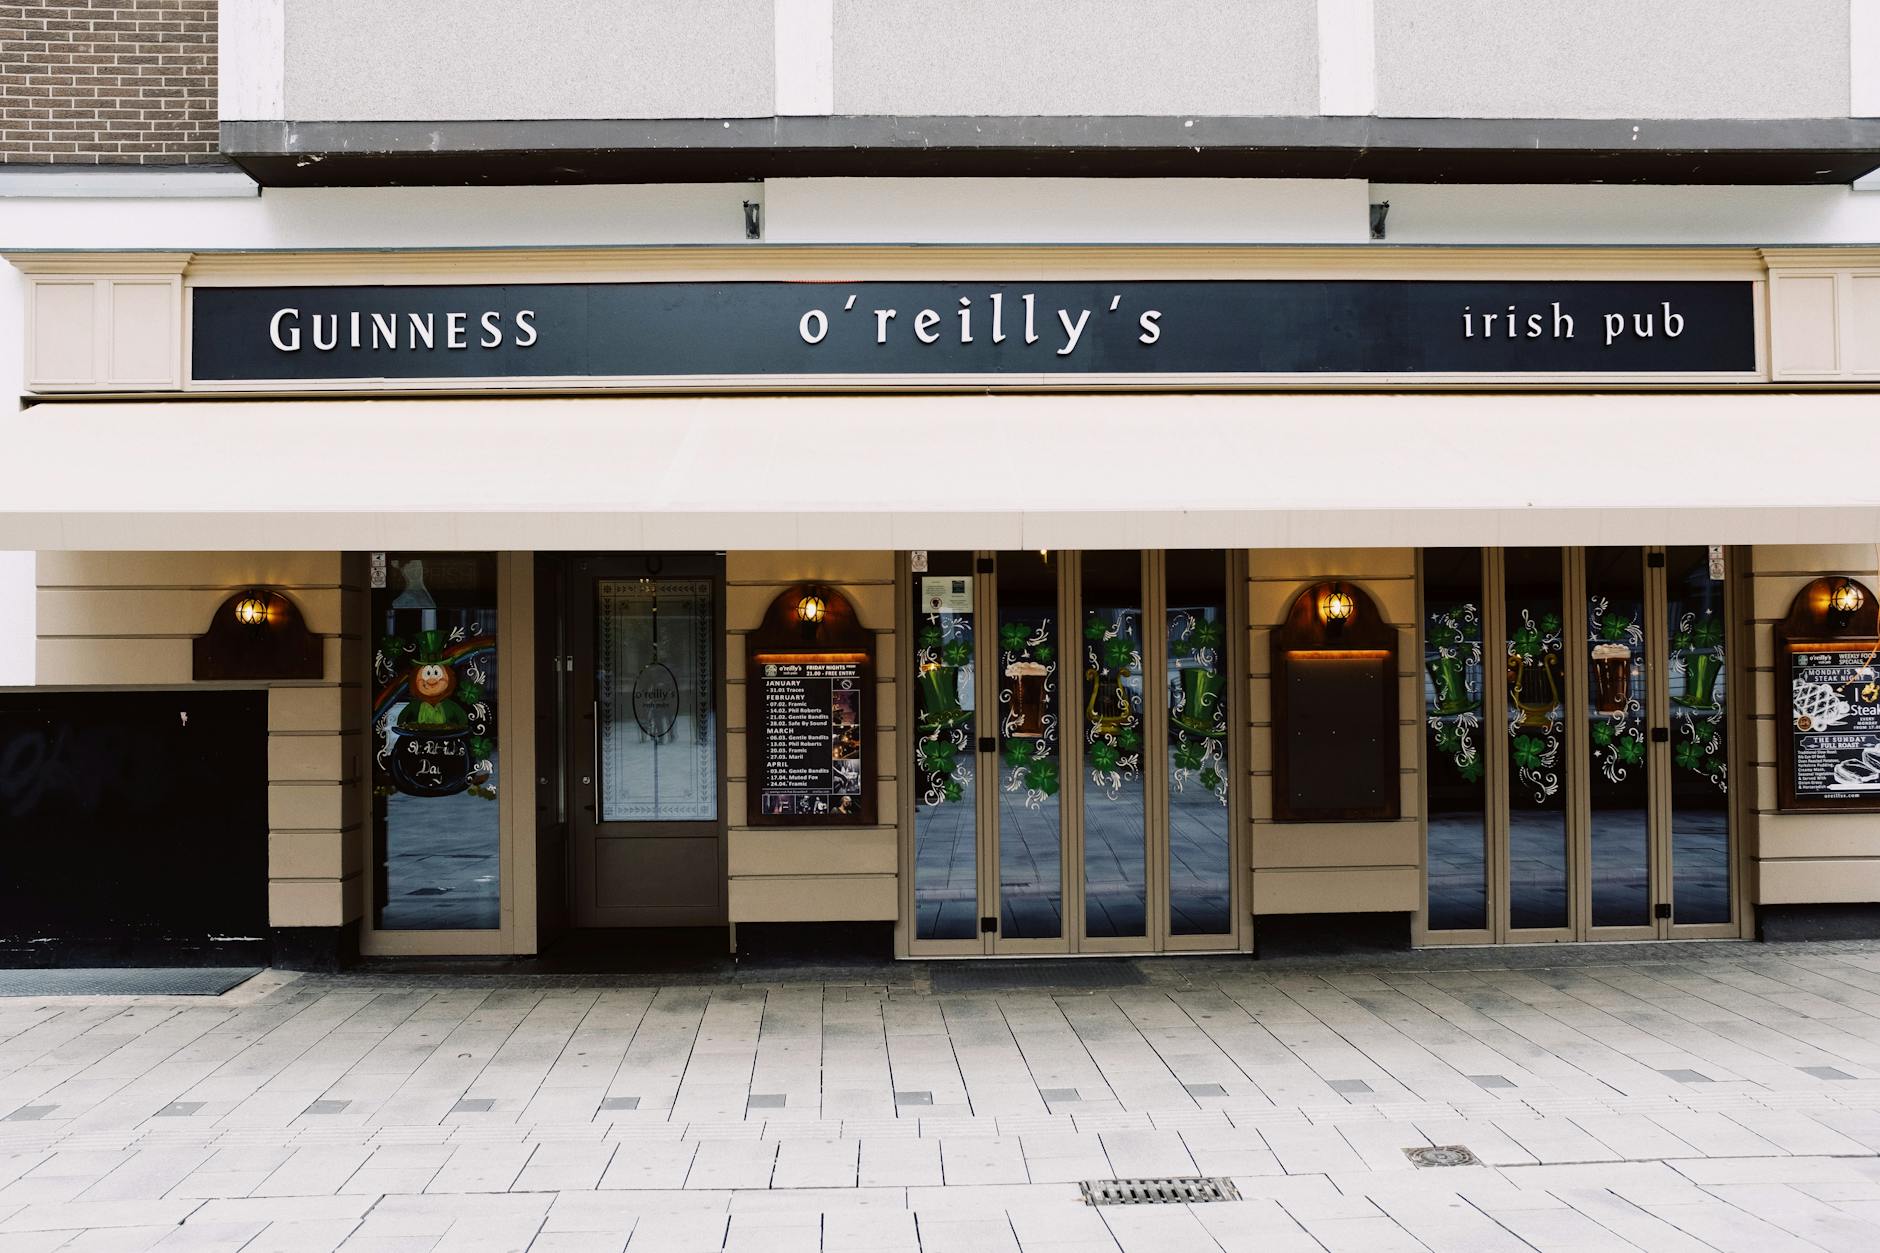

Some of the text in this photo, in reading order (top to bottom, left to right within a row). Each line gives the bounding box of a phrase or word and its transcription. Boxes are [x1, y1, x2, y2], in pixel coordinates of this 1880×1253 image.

[269, 308, 538, 351] GUINNESS
[799, 293, 1163, 355] o'reilly's
[1462, 301, 1685, 346] irish pub
